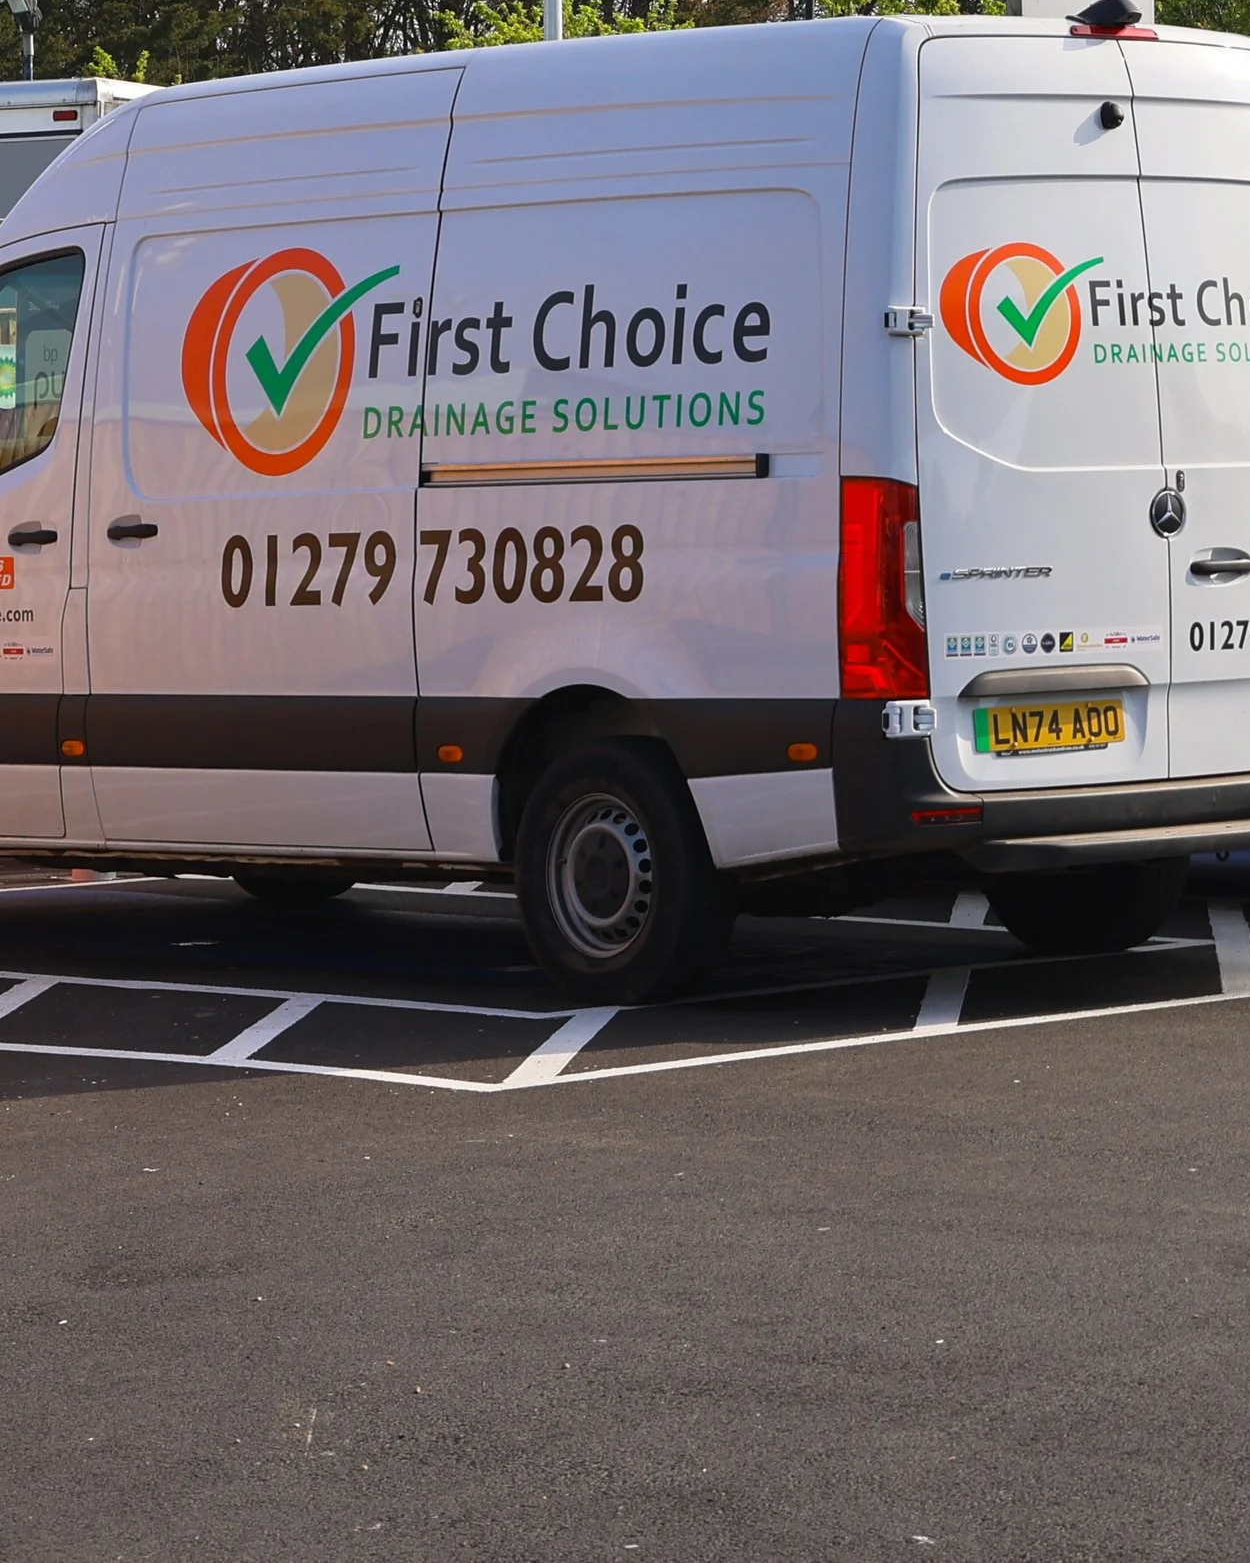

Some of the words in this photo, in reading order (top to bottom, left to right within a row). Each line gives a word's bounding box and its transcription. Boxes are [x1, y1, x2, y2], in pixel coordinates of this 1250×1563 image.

[1089, 279, 1183, 327] First
[43, 344, 58, 364] bp
[368, 297, 513, 380] First
[533, 284, 771, 372] Choice
[1094, 343, 1207, 364] DRAINAGE
[363, 399, 536, 439] DRAINAGE
[553, 391, 765, 432] SOLUTIONS
[221, 532, 396, 608] 01279
[420, 525, 644, 605] 730828
[993, 710, 1062, 745] LN74
[1072, 705, 1119, 739] AOO
